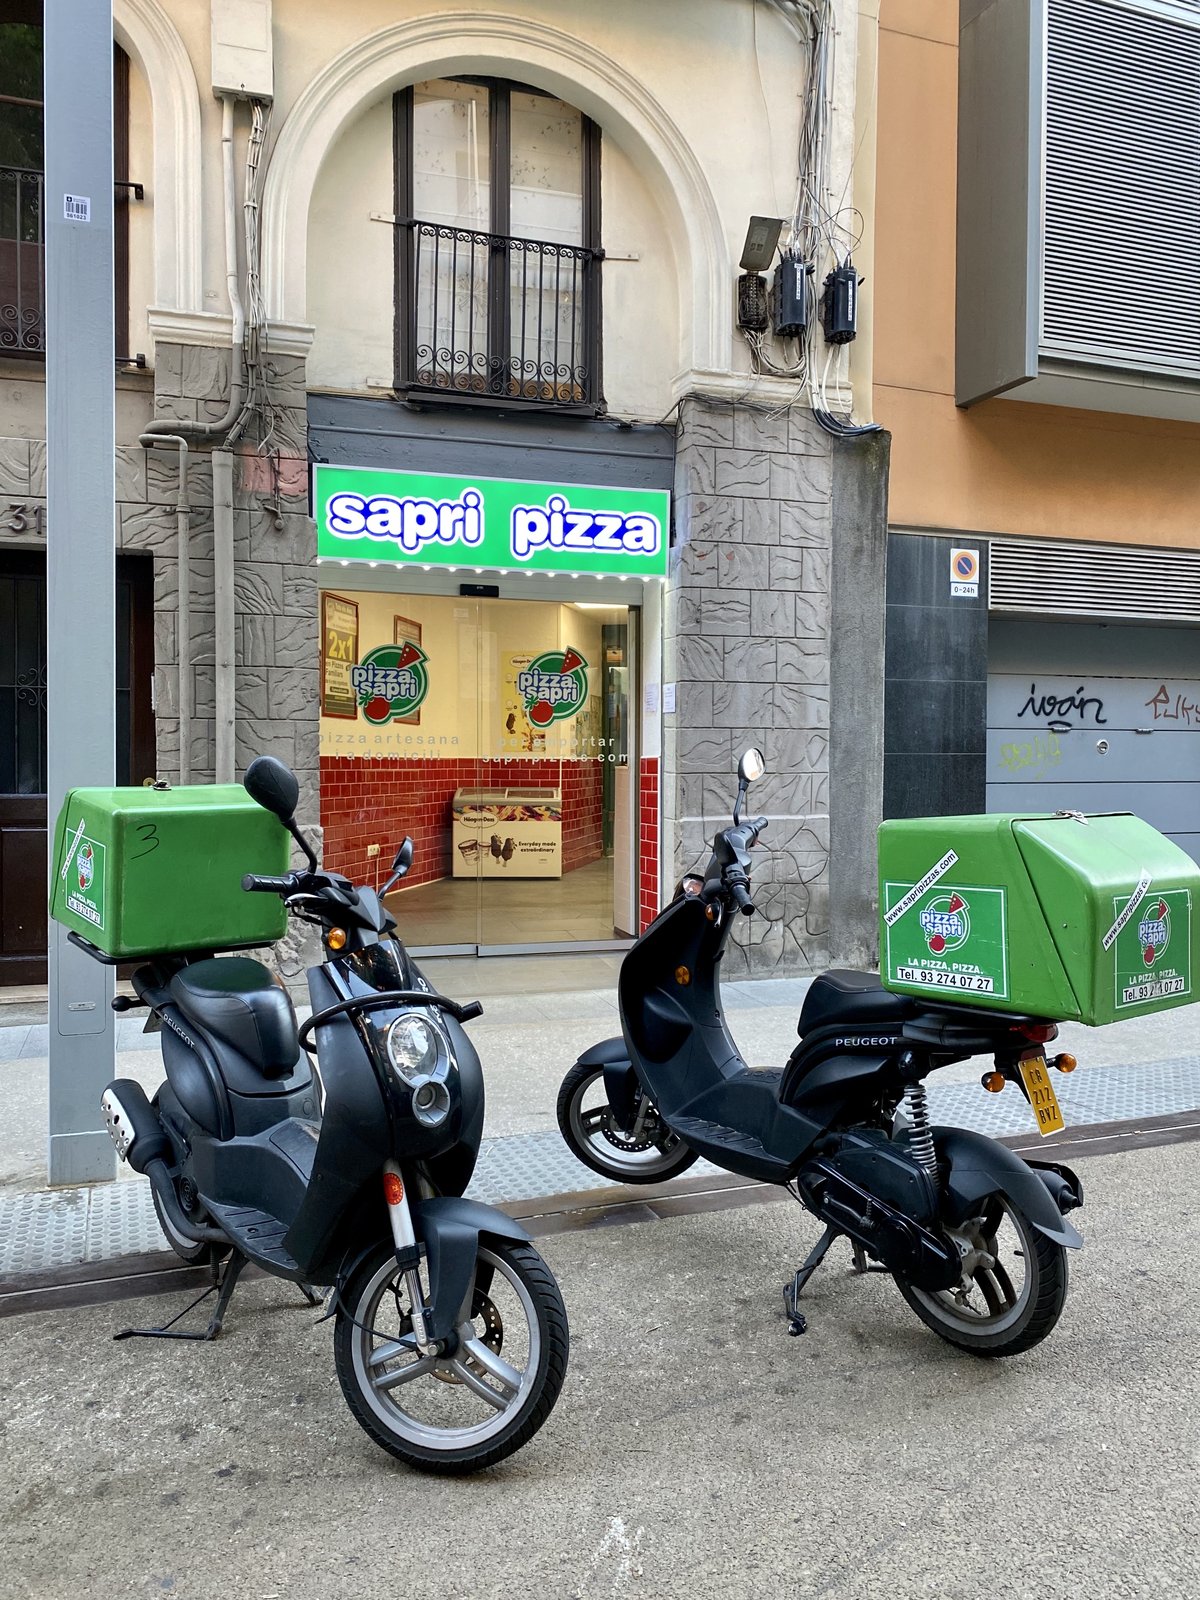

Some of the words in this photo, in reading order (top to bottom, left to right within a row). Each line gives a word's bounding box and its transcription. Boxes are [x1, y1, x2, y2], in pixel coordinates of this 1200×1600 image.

[8, 503, 42, 534] 31
[328, 489, 482, 552] sapri
[511, 495, 658, 558] pizza
[953, 586, 976, 594] 0-24h
[328, 631, 353, 660] 2x1
[352, 663, 412, 687] pizza
[519, 668, 574, 691] pizza
[359, 677, 417, 700] sapri
[524, 683, 579, 705] sapri
[374, 733, 459, 745] artesana
[346, 751, 356, 761] a
[362, 749, 441, 761] domicili
[131, 824, 160, 860] 3
[886, 852, 956, 923] www.sapripizzas.com
[921, 908, 960, 926] pizza
[925, 920, 963, 937] sapri
[1140, 919, 1165, 937] pizza
[1142, 928, 1167, 947] sapri
[907, 957, 918, 967] LA
[921, 959, 951, 971] PIZZA,
[952, 962, 984, 974] PIZZA.
[899, 968, 918, 981] Tel.
[921, 970, 934, 982] 93
[936, 973, 957, 986] 274
[960, 976, 973, 988] 07
[976, 978, 991, 990] 27
[1129, 976, 1137, 985] LA
[1138, 971, 1157, 983] PIZZA
[1124, 988, 1138, 1001] Tel.
[1139, 985, 1148, 998] 93
[1149, 981, 1163, 997] 24
[1164, 980, 1173, 993] 07
[1174, 978, 1183, 992] 27
[163, 1013, 195, 1048] PEUGEOT
[835, 1036, 898, 1047] PEUGEOT
[1033, 1086, 1053, 1105] 212
[1039, 1105, 1058, 1124] BVZ
